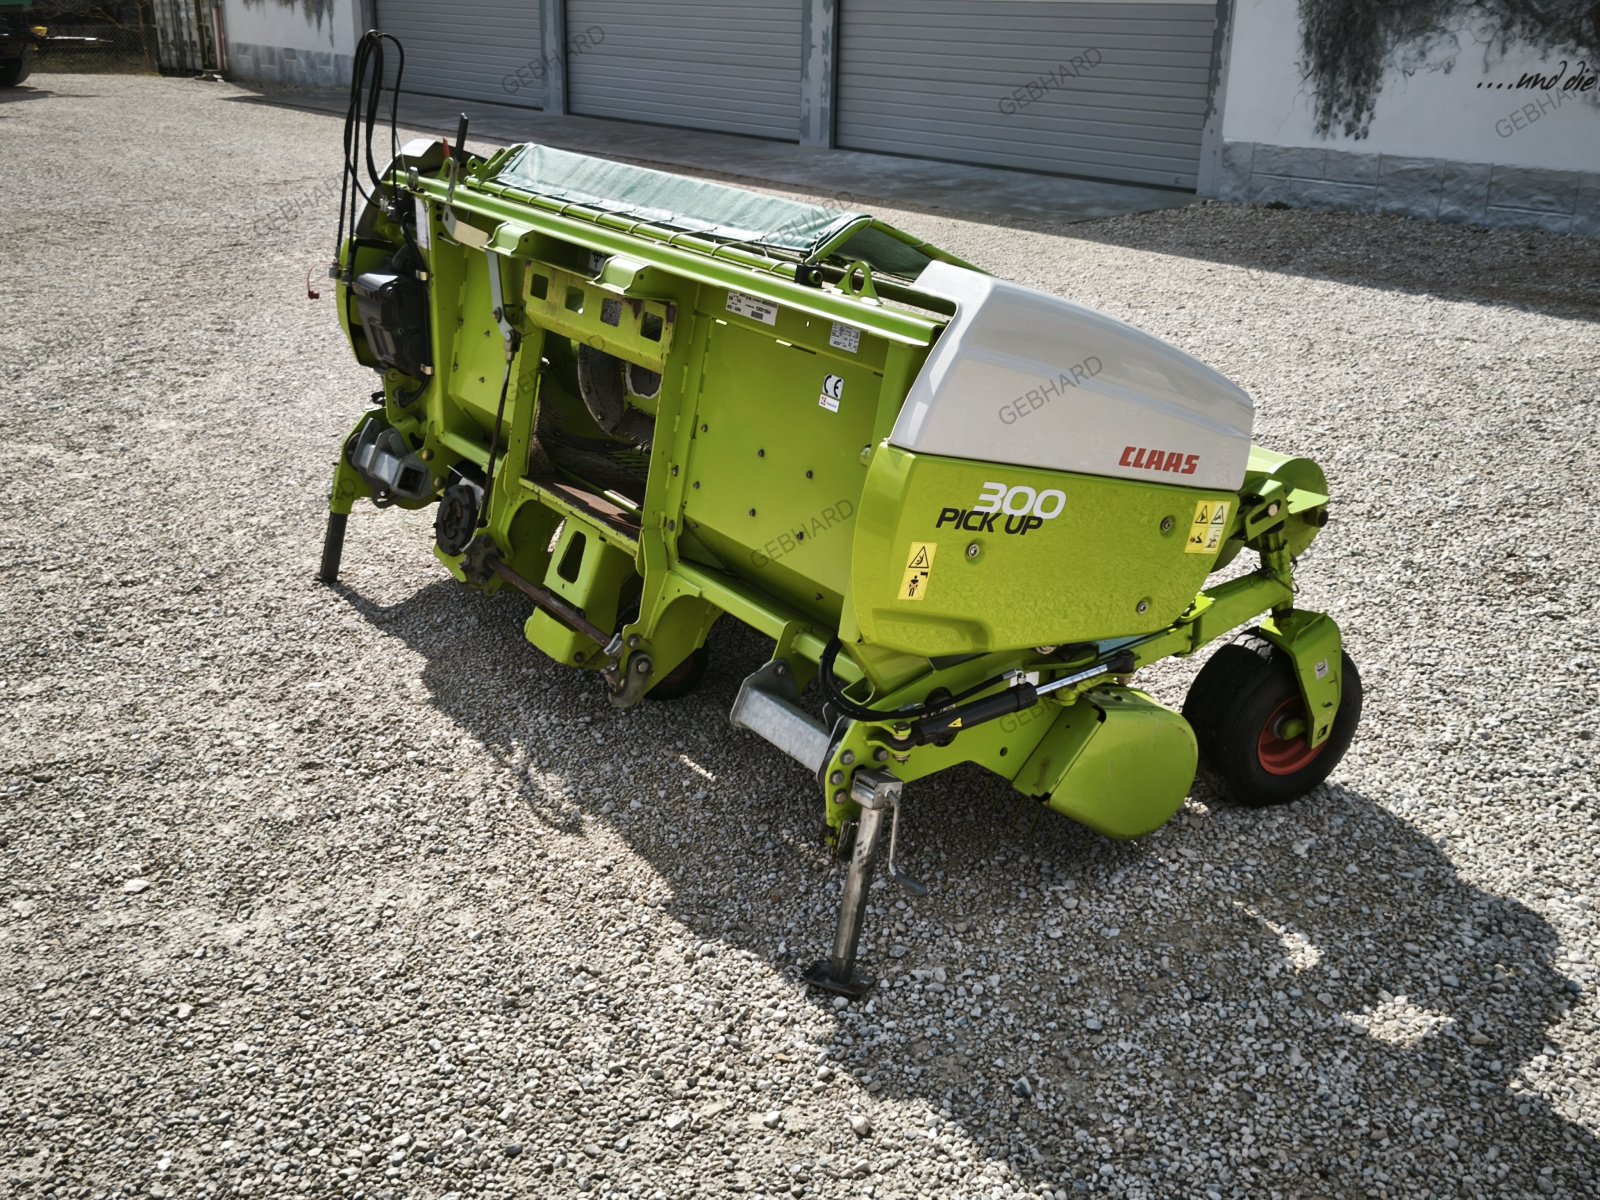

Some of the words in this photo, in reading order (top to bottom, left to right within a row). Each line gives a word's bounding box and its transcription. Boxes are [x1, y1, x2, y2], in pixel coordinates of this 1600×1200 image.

[1562, 60, 1595, 92] die
[1118, 446, 1200, 475] CLAAS
[972, 481, 1067, 520] 300
[935, 508, 1002, 533] PICK
[1004, 515, 1043, 535] UP
